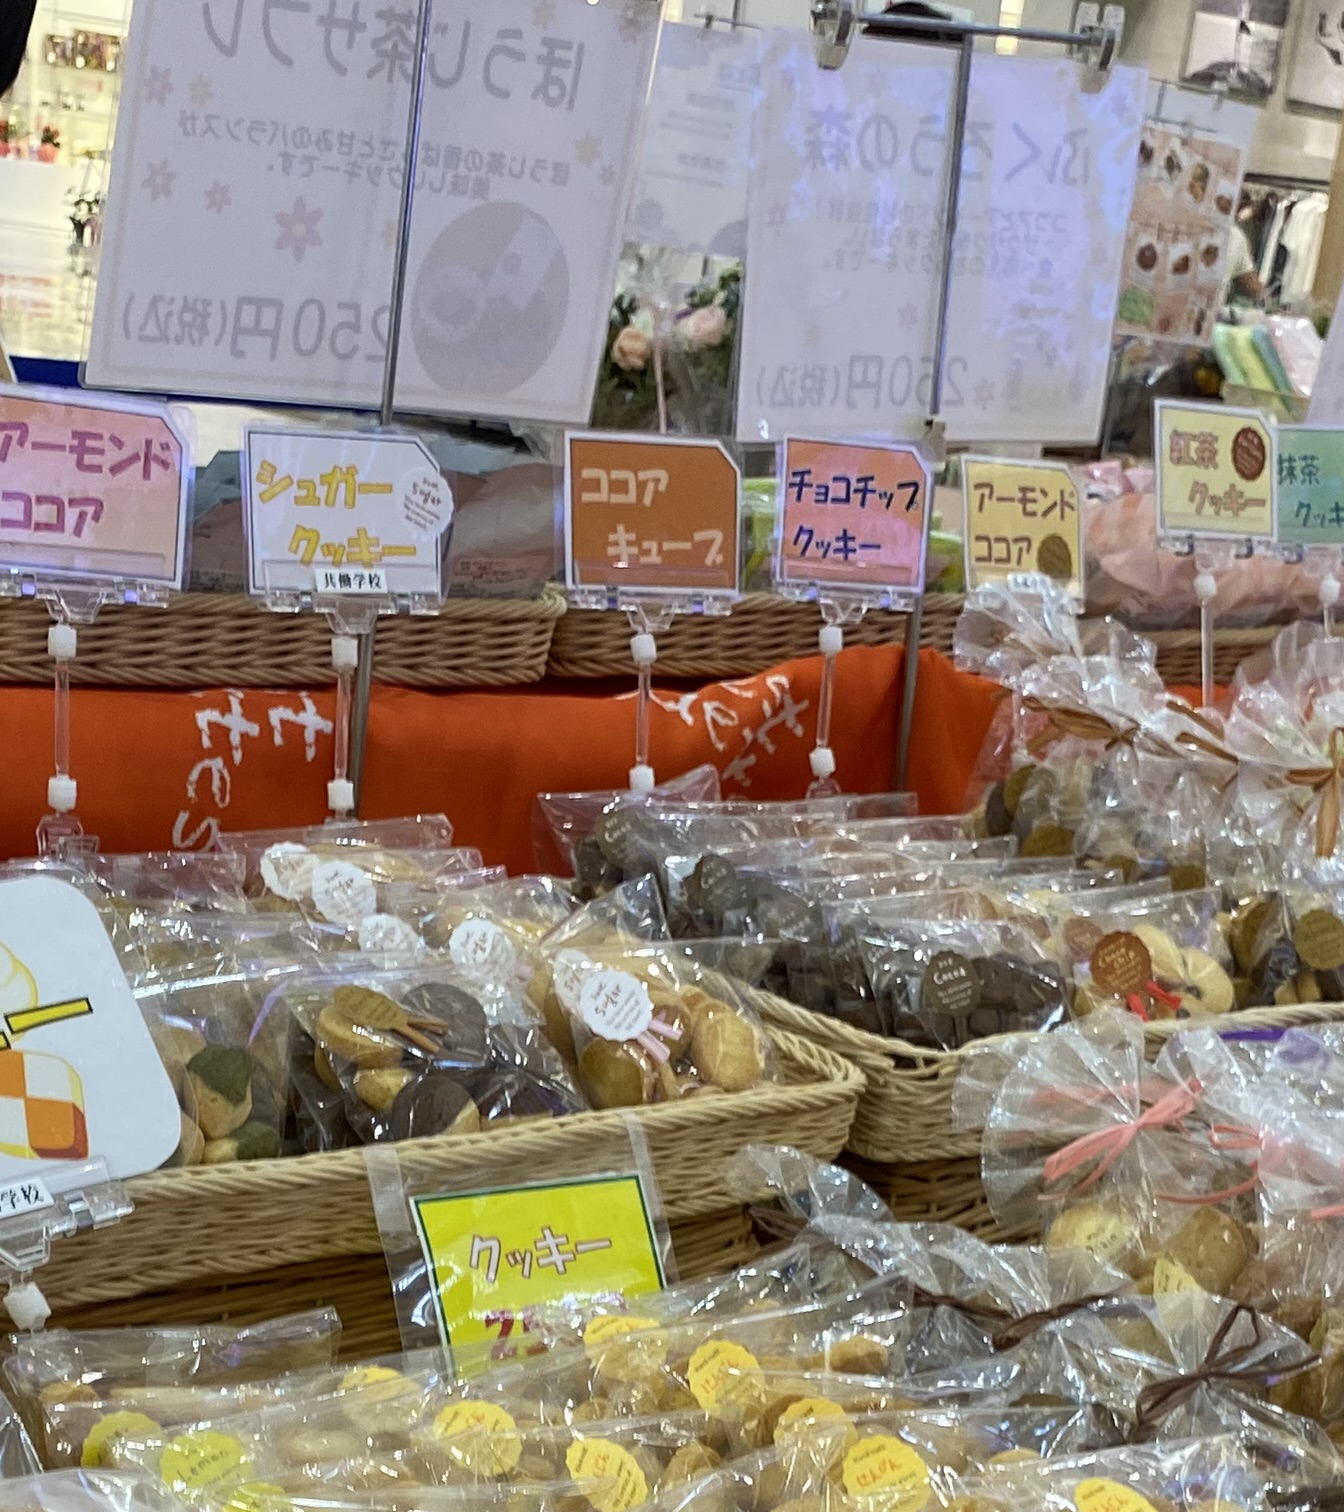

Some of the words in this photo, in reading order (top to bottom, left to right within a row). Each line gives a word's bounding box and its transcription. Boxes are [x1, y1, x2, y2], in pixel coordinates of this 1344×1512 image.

[1169, 429, 1219, 471] 紅茶
[1277, 453, 1320, 486] 抹茶
[256, 459, 393, 509] シュガー
[581, 468, 669, 507] ココア
[788, 468, 920, 513] チョコチップ
[973, 481, 1076, 521] アーモンド
[1188, 480, 1266, 517] クッキー
[288, 524, 417, 569] クッキー
[607, 524, 724, 567] キューブ
[793, 525, 881, 560] クッキー
[974, 535, 1033, 567] ココア
[468, 1224, 613, 1283] クッキー
